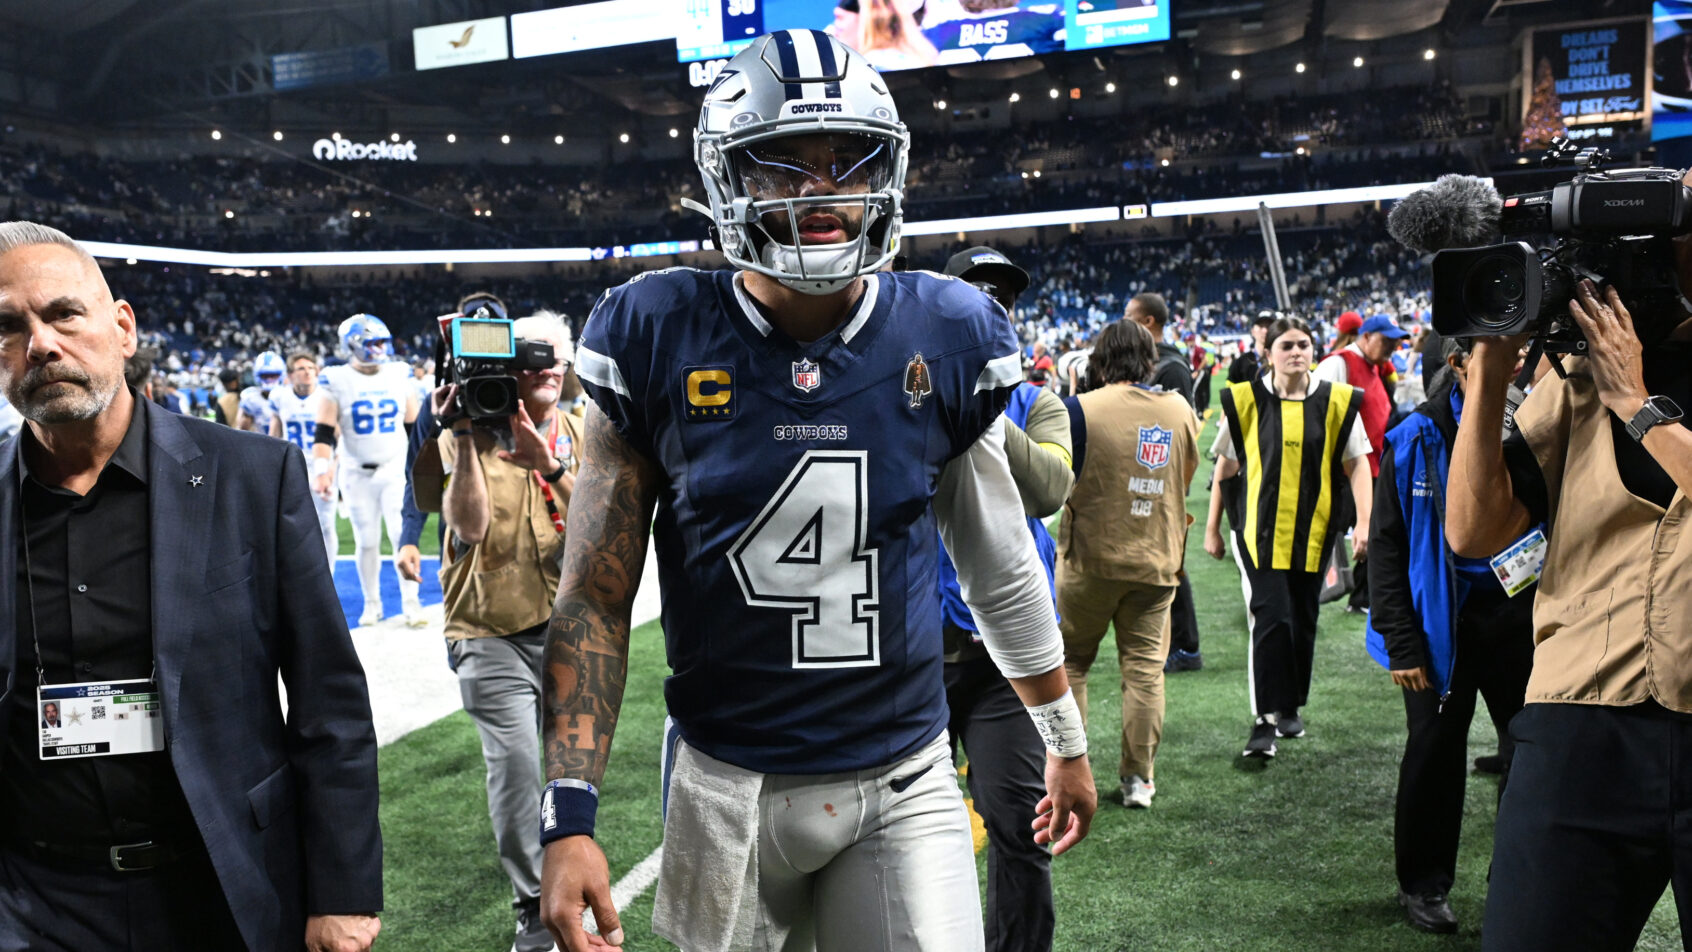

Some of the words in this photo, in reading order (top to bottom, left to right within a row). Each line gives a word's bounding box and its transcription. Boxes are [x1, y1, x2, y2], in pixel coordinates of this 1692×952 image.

[958, 20, 1009, 47] BASS
[1561, 29, 1618, 48] DREAMS
[1568, 45, 1610, 62] DON'T
[1568, 61, 1609, 78] DRIVE
[791, 103, 842, 115] COWBOYS
[1580, 98, 1604, 114] SET
[336, 139, 418, 161] Rocket
[1525, 196, 1545, 204] SONY
[1604, 199, 1645, 207] XDCAM
[687, 370, 731, 407] C
[797, 373, 817, 387] NFL
[351, 398, 399, 436] 62
[774, 425, 848, 440] COWBOYS
[1141, 443, 1166, 464] NFL
[1128, 476, 1164, 495] MEDIA
[726, 450, 881, 669] 4
[56, 745, 80, 755] VISITING
[81, 744, 96, 754] TEAM
[540, 788, 557, 832] 4
